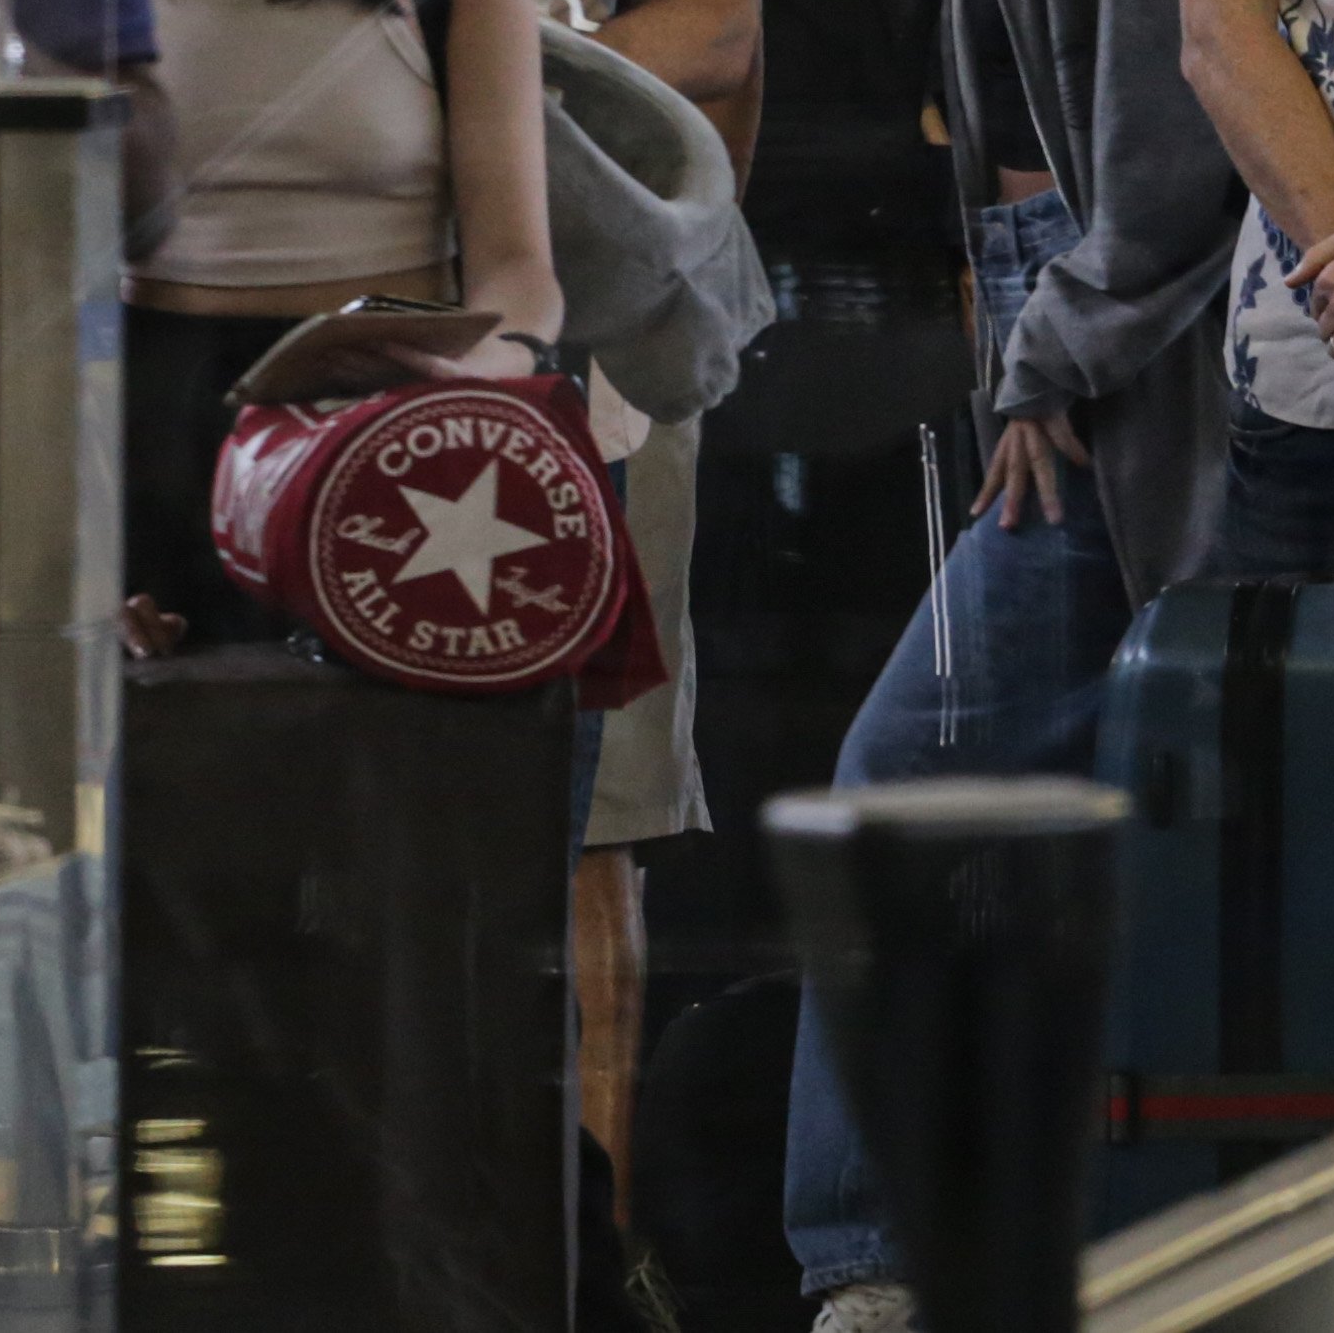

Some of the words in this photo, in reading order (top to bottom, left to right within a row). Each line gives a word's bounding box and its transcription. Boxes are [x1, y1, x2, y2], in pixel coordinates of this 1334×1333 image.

[377, 418, 587, 539] CONVERSE
[340, 568, 402, 635] ALL
[409, 619, 526, 657] STAR
